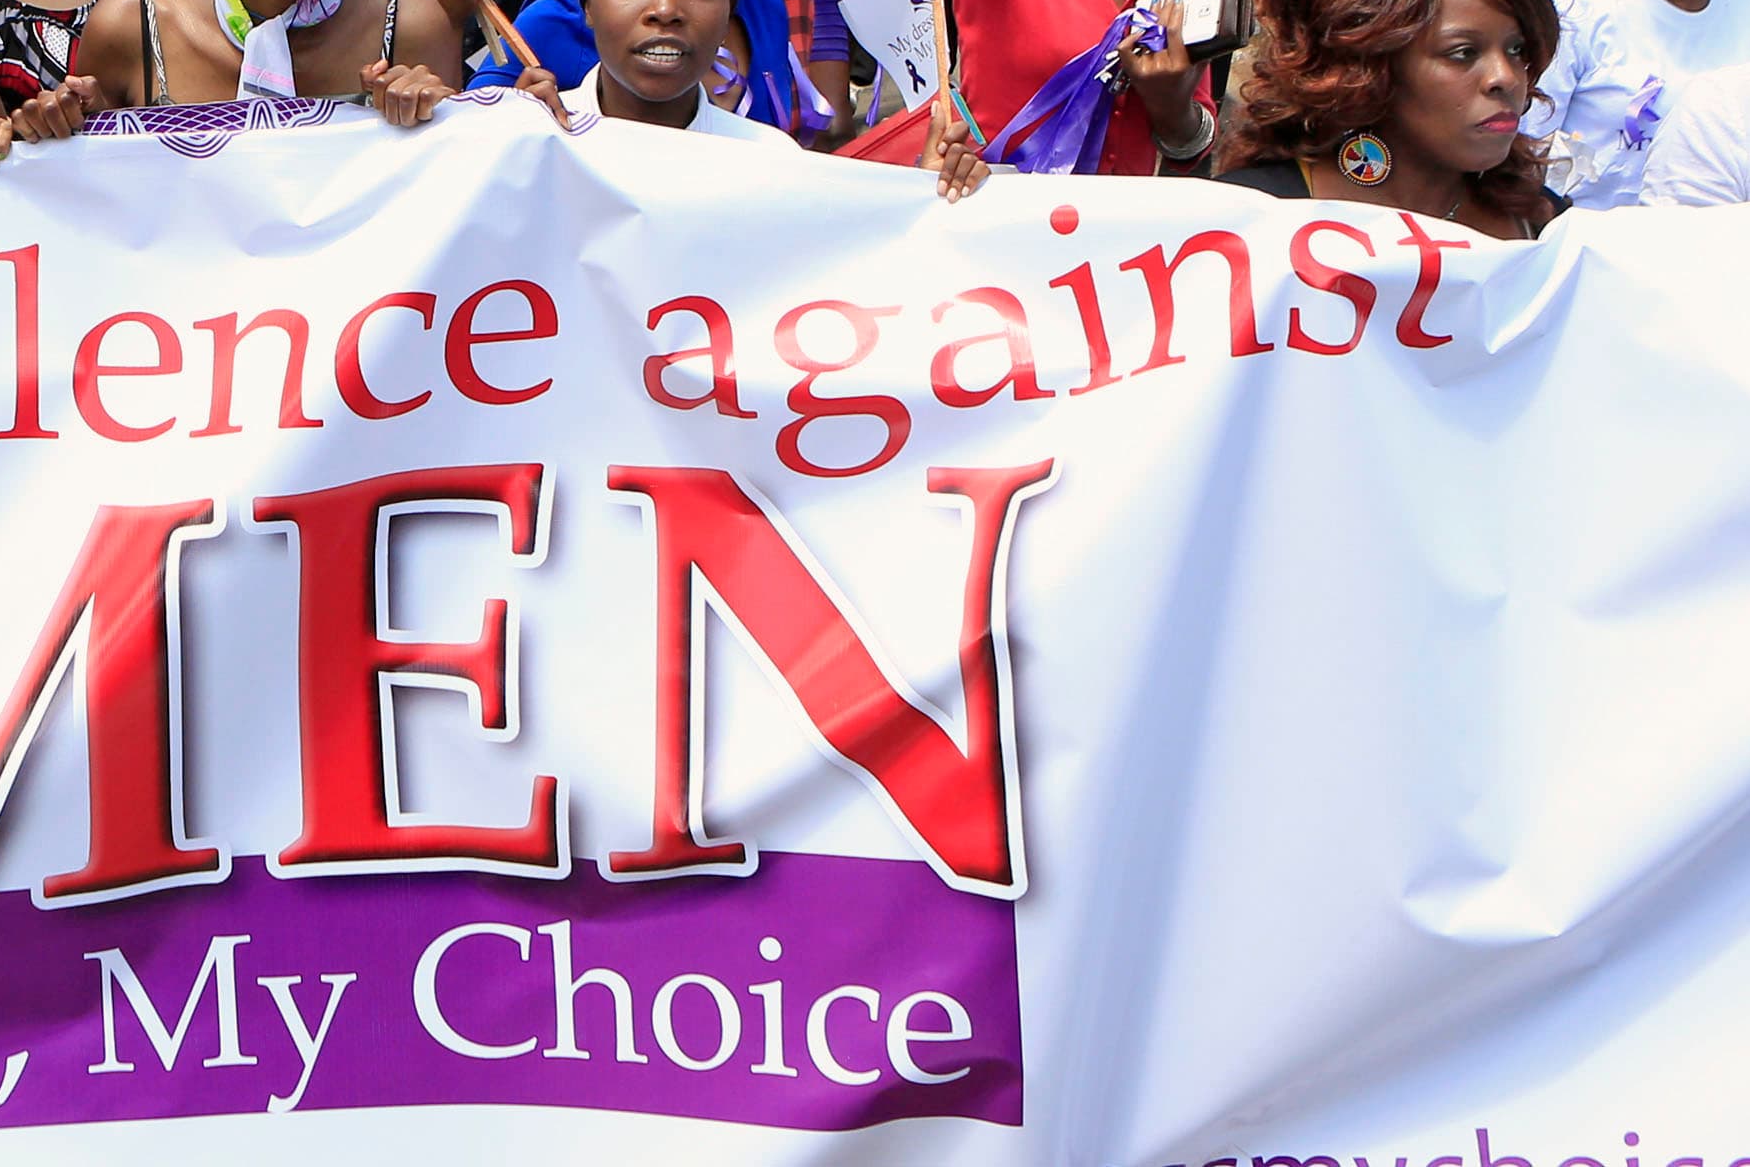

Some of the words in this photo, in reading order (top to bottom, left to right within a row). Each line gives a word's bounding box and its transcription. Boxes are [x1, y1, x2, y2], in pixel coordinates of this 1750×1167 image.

[887, 35, 913, 58] My
[913, 39, 935, 63] My
[642, 205, 1472, 479] against
[83, 934, 357, 1114] My
[413, 919, 974, 1088] Choice
